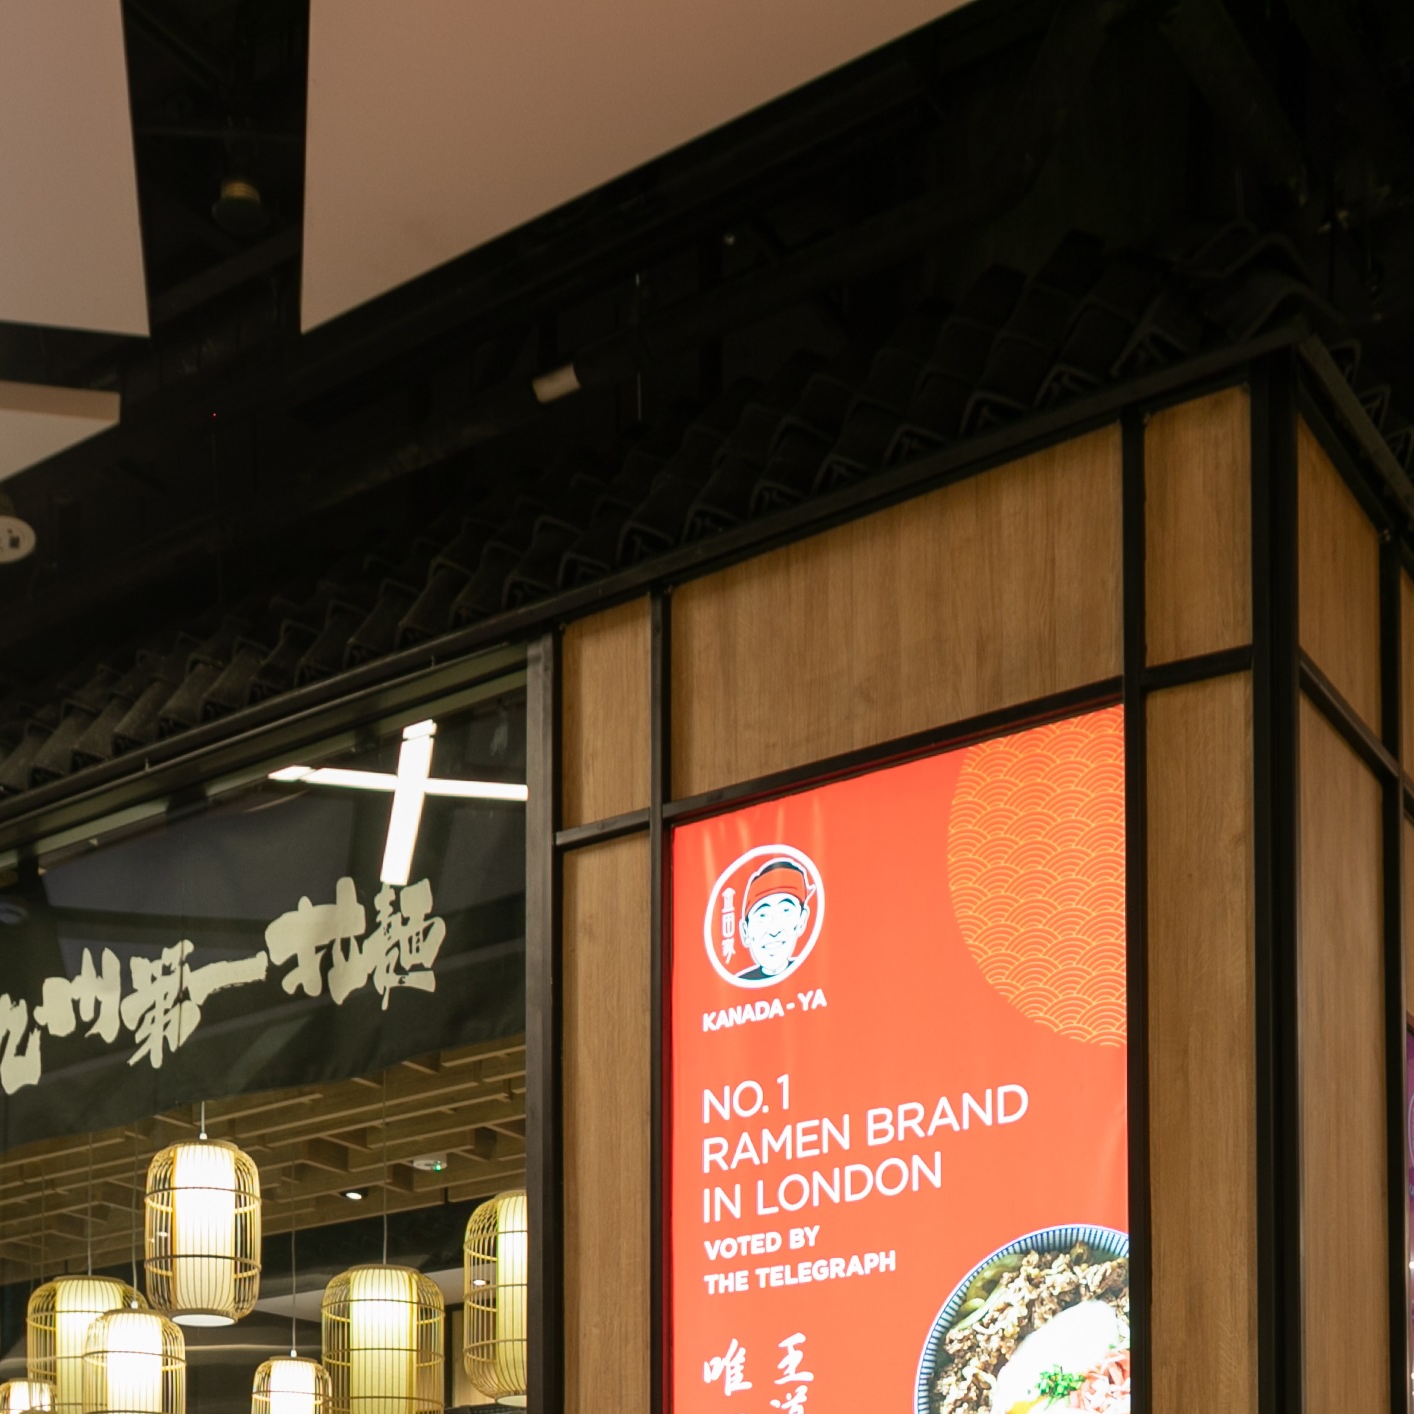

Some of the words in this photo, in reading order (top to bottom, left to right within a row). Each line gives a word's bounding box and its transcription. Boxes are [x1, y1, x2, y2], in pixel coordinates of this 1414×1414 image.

[701, 1114, 851, 1174] RAMEN
[866, 1083, 1030, 1148] BRAND
[702, 1182, 741, 1224] IN
[756, 1151, 943, 1216] LONDON
[704, 1231, 782, 1261] VOTED
[790, 1225, 820, 1251] BY
[704, 1270, 750, 1296] THE
[755, 1249, 897, 1289] TELEGRAPH
